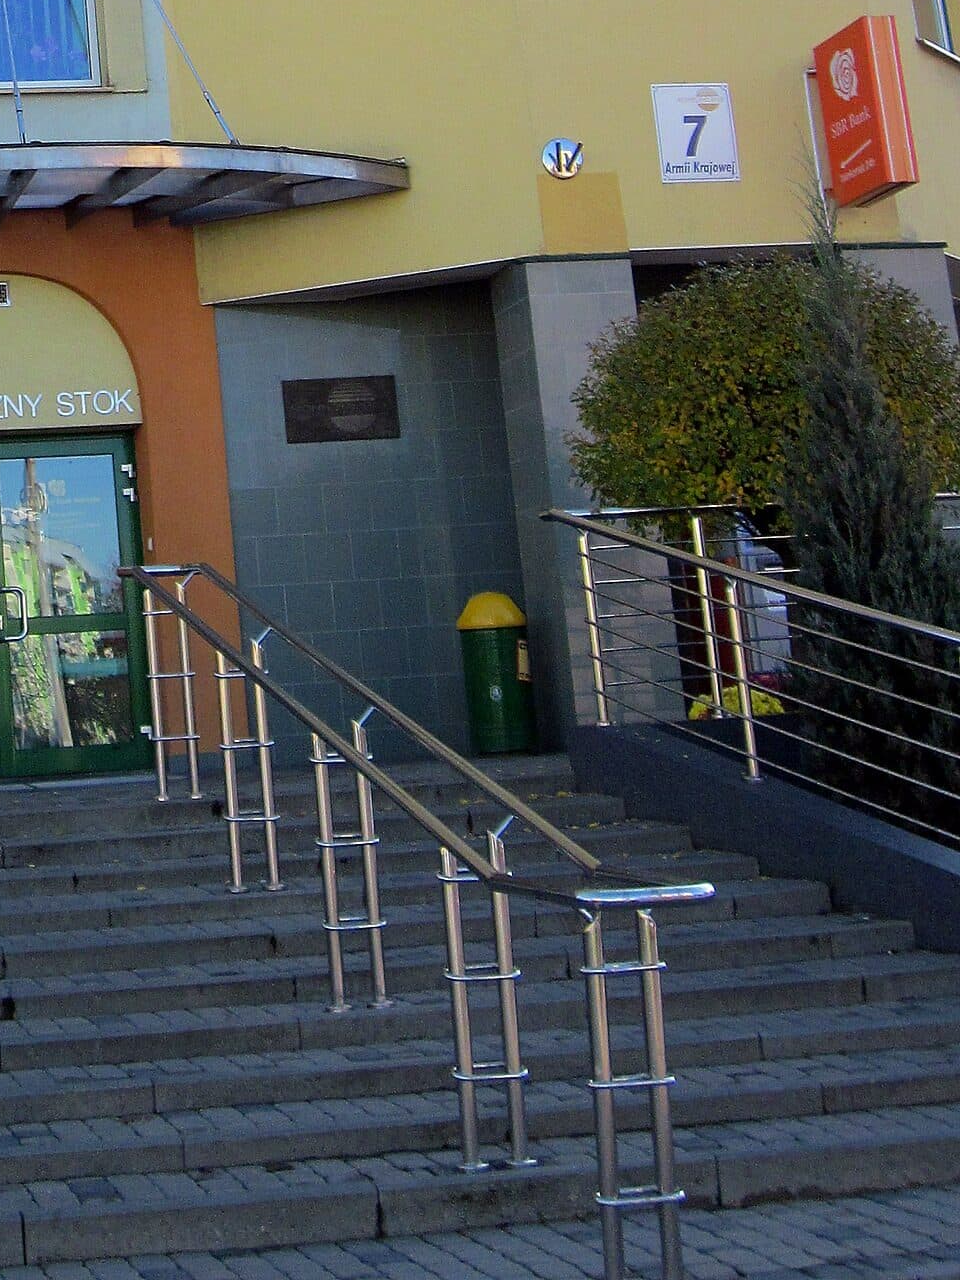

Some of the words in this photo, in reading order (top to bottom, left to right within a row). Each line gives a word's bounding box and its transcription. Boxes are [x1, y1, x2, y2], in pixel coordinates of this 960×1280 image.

[683, 115, 707, 157] 7
[665, 162, 691, 174] Armii
[693, 161, 736, 175] Krajowej
[56, 388, 135, 417] STOK
